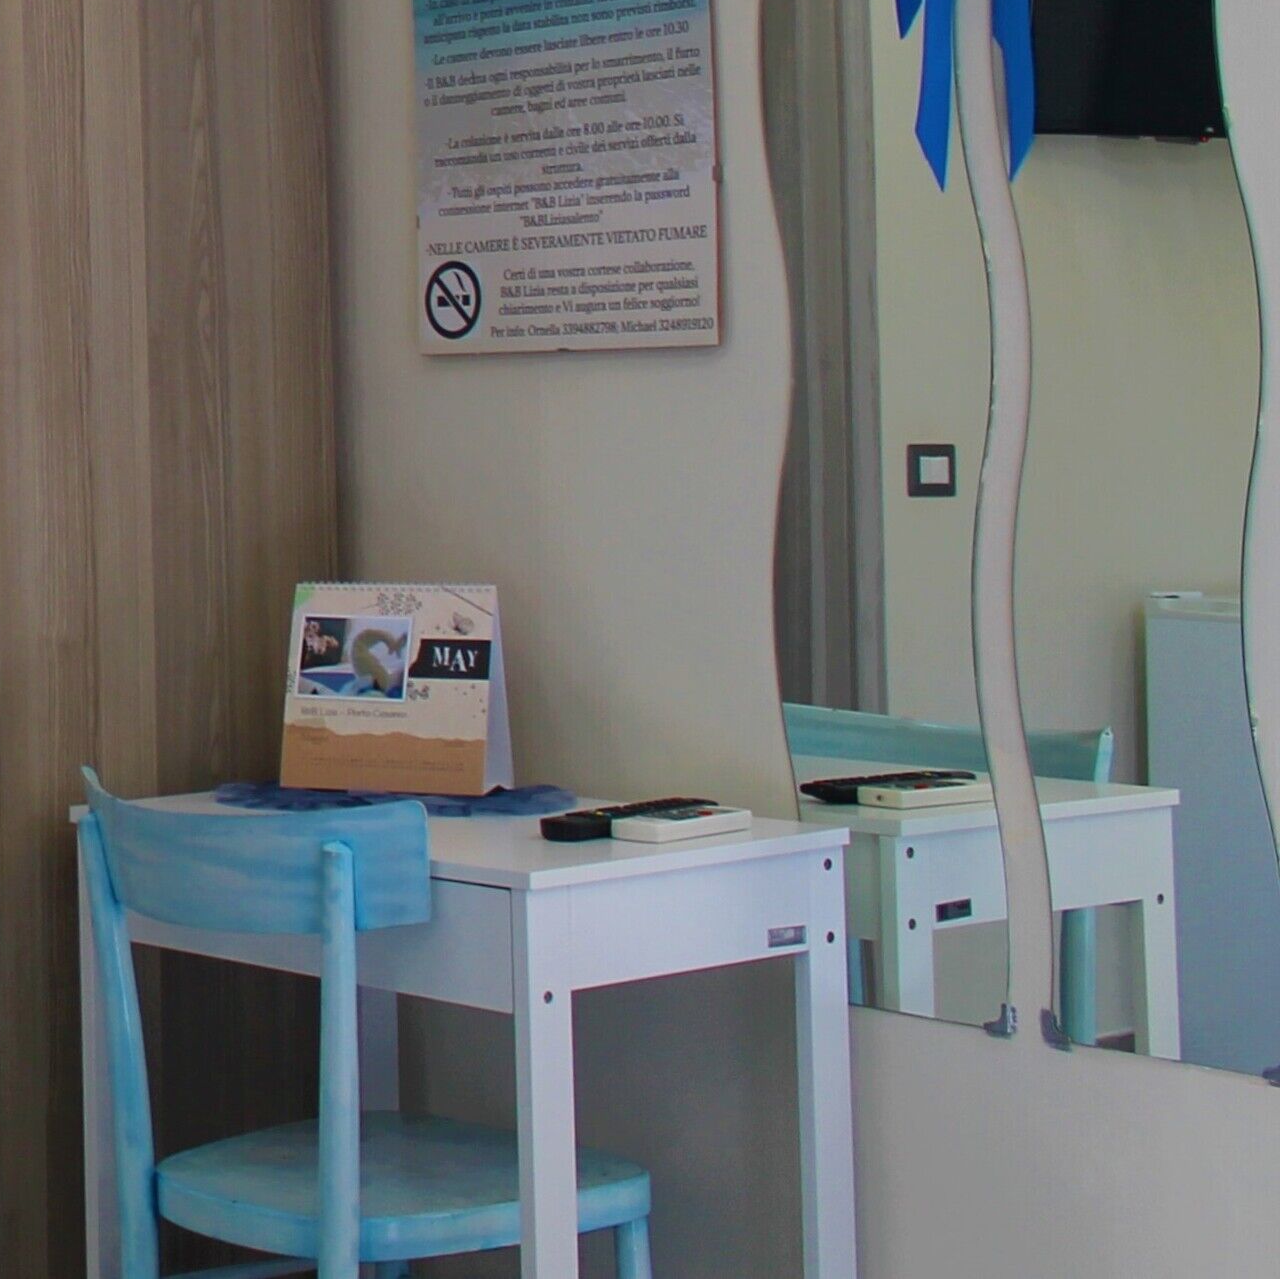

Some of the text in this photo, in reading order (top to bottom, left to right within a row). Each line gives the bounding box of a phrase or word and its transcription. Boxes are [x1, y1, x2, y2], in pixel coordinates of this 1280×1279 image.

[464, 238, 510, 255] CAMERE
[520, 231, 604, 251] SEVERAMENTE
[604, 227, 657, 245] VIETATO
[657, 223, 708, 242] FUMARE
[432, 646, 479, 672] MAY
